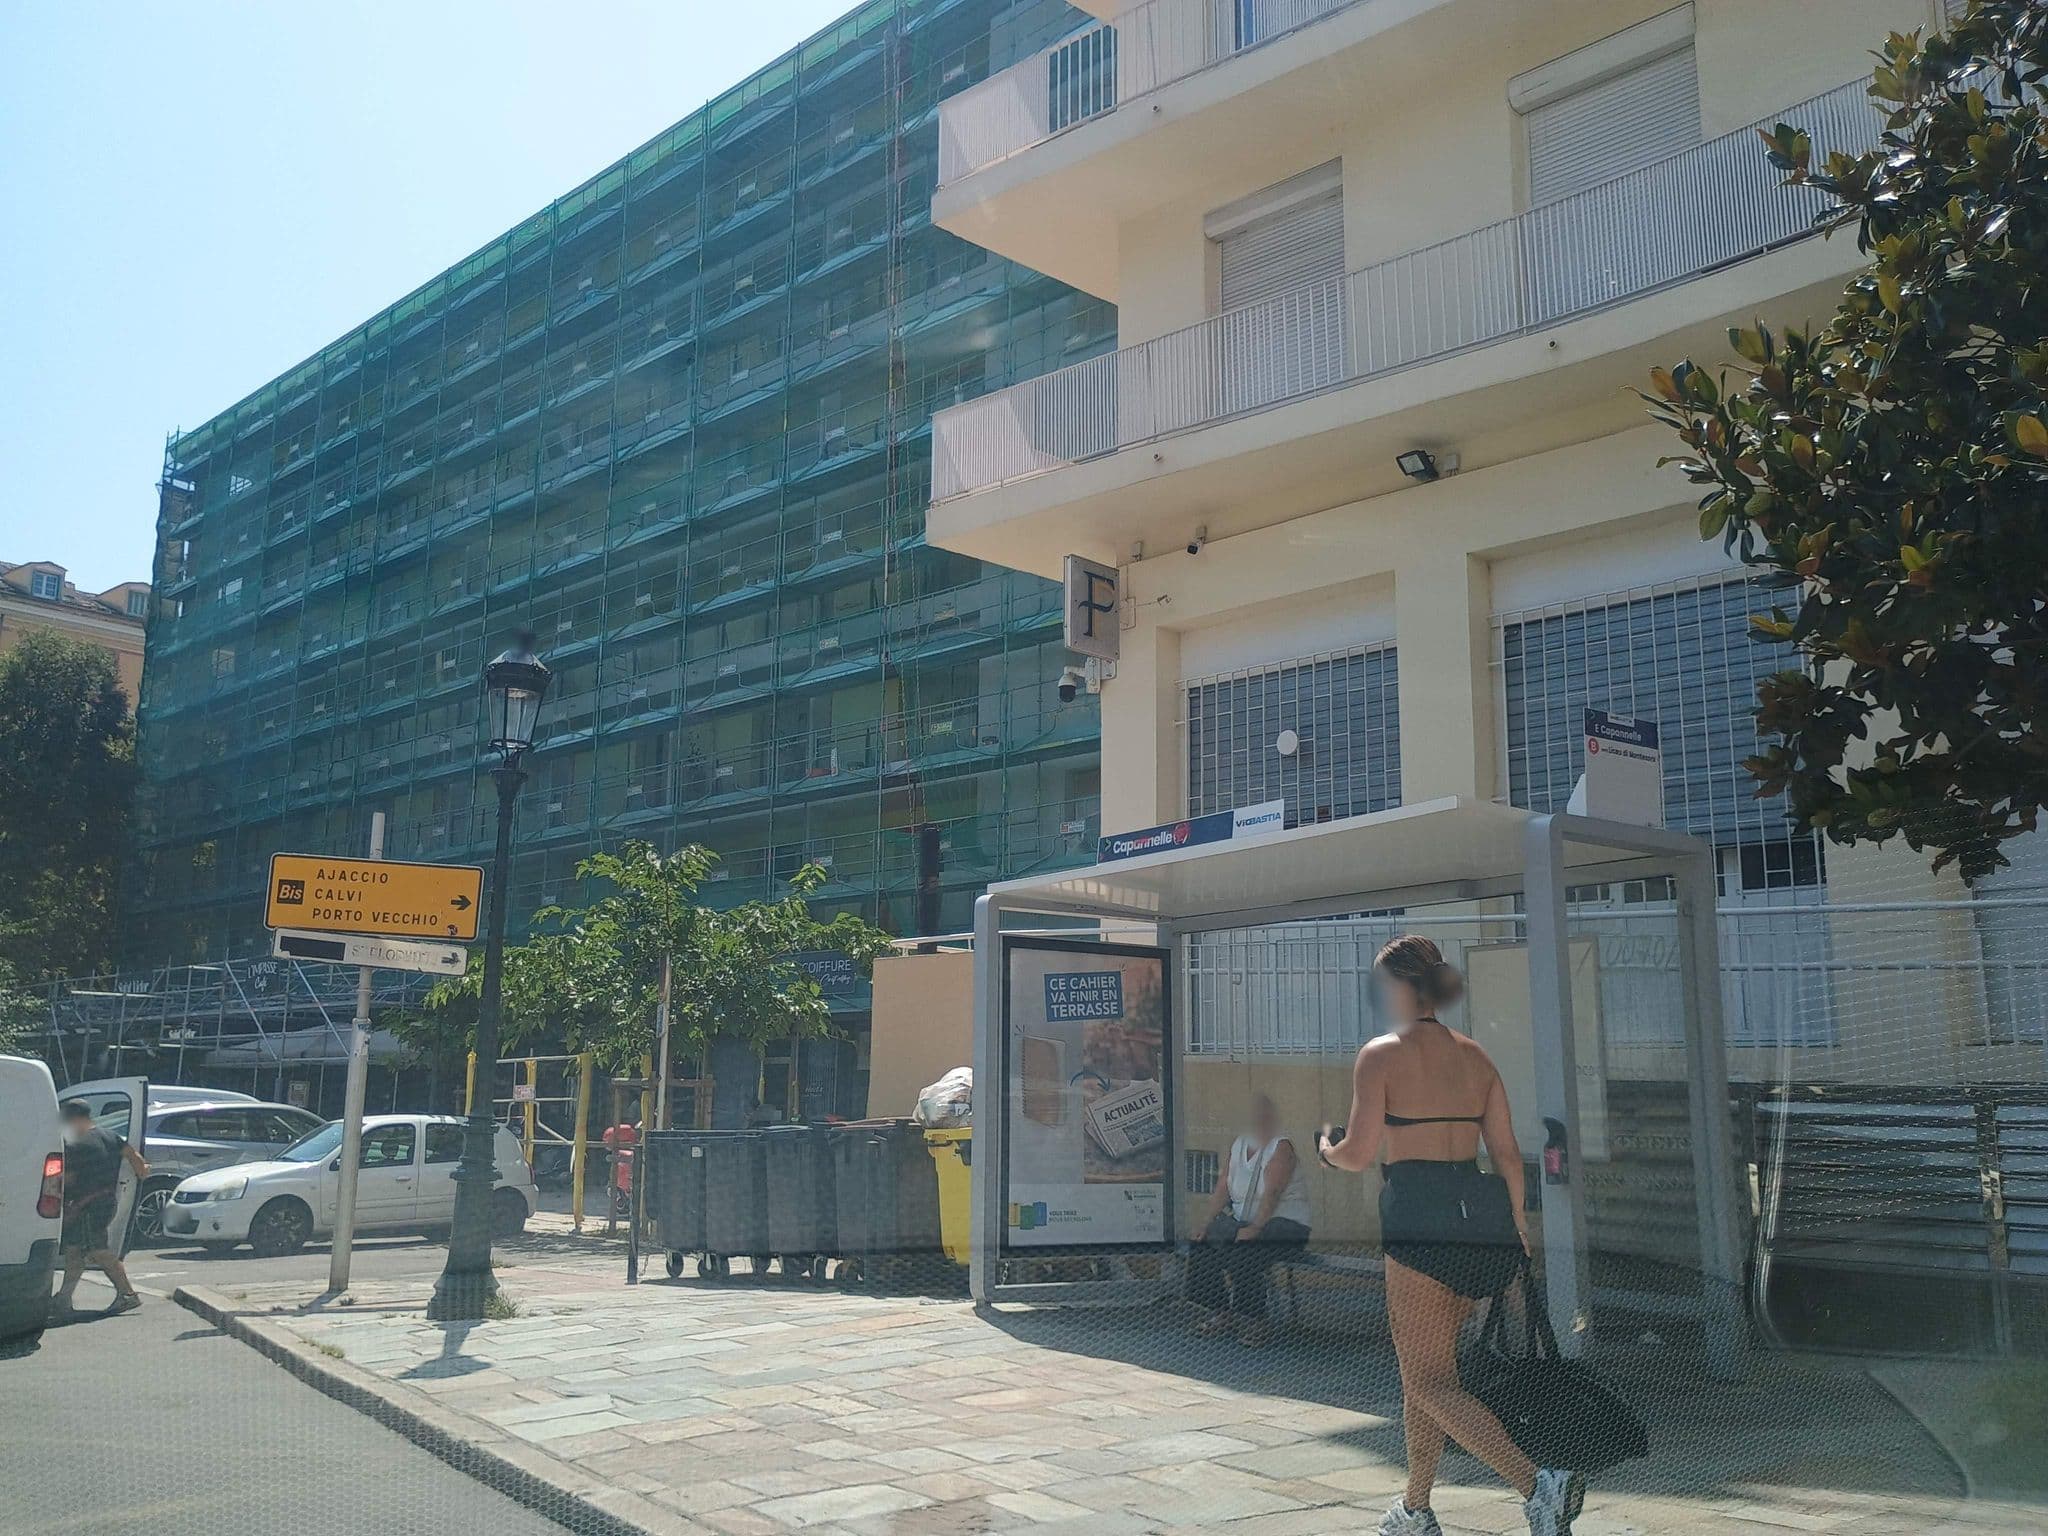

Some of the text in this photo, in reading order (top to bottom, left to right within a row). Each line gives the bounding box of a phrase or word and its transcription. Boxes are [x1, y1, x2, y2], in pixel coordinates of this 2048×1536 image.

[1113, 831, 1172, 856] Capannelle
[316, 868, 389, 884] AJACCIO
[279, 884, 303, 900] Bis
[314, 888, 362, 902] CALVI
[312, 907, 438, 926] PORTO VECCHIO
[1050, 976, 1116, 990] CE CAHIER
[1051, 989, 1117, 1003] VA FINIR EN
[1051, 1002, 1118, 1018] TERRASSE
[1104, 1091, 1158, 1123] ACTUALITÉ
